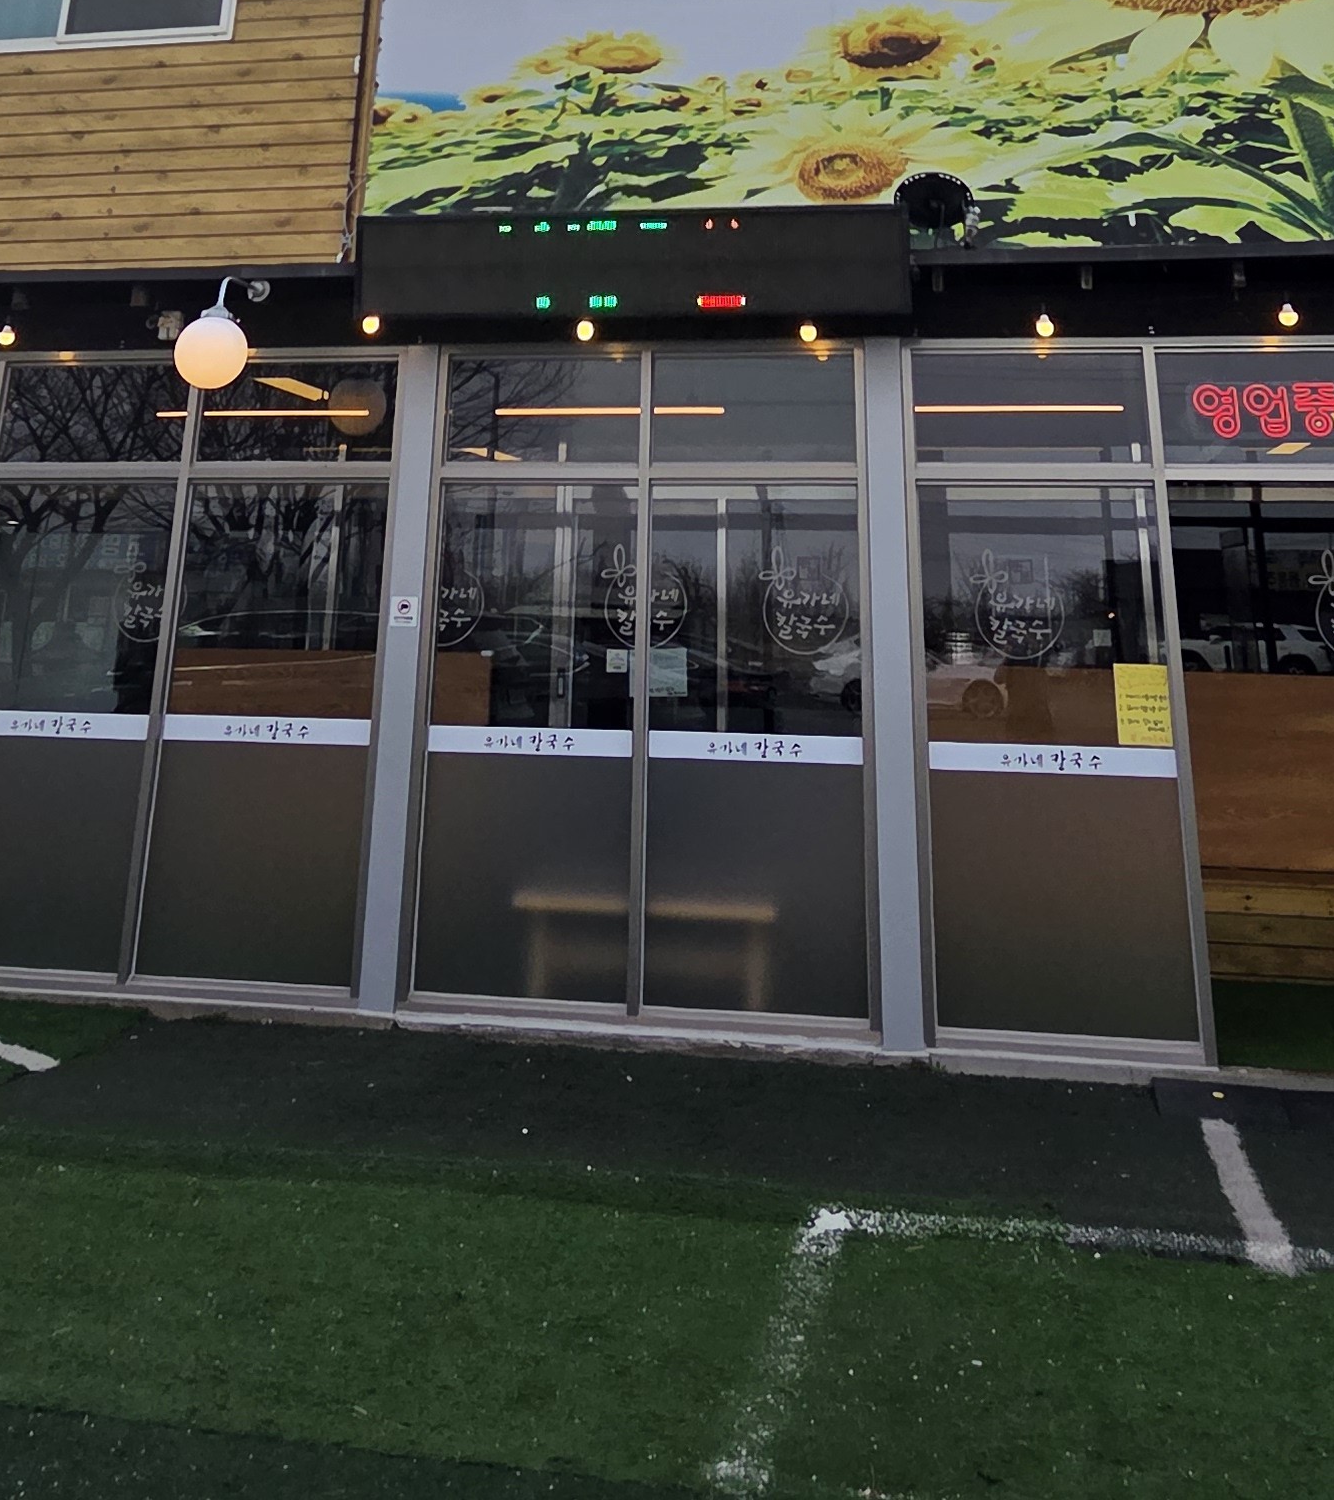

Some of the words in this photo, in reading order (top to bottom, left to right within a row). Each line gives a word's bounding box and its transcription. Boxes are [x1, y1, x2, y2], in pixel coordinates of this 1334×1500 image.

[127, 581, 165, 600] 유가
[440, 586, 478, 600] 가네
[776, 587, 842, 607] 유가네
[989, 592, 1055, 613] 유가네
[438, 607, 472, 632] 국수
[775, 612, 835, 640] 칼국수
[988, 616, 1052, 645] 칼국수
[484, 734, 523, 749] 유가네
[529, 732, 574, 752] 칼국수
[707, 741, 747, 756] 유가네
[754, 738, 802, 759] 칼국수
[1000, 752, 1043, 768] 유가네
[1050, 749, 1102, 771] 칼국수
